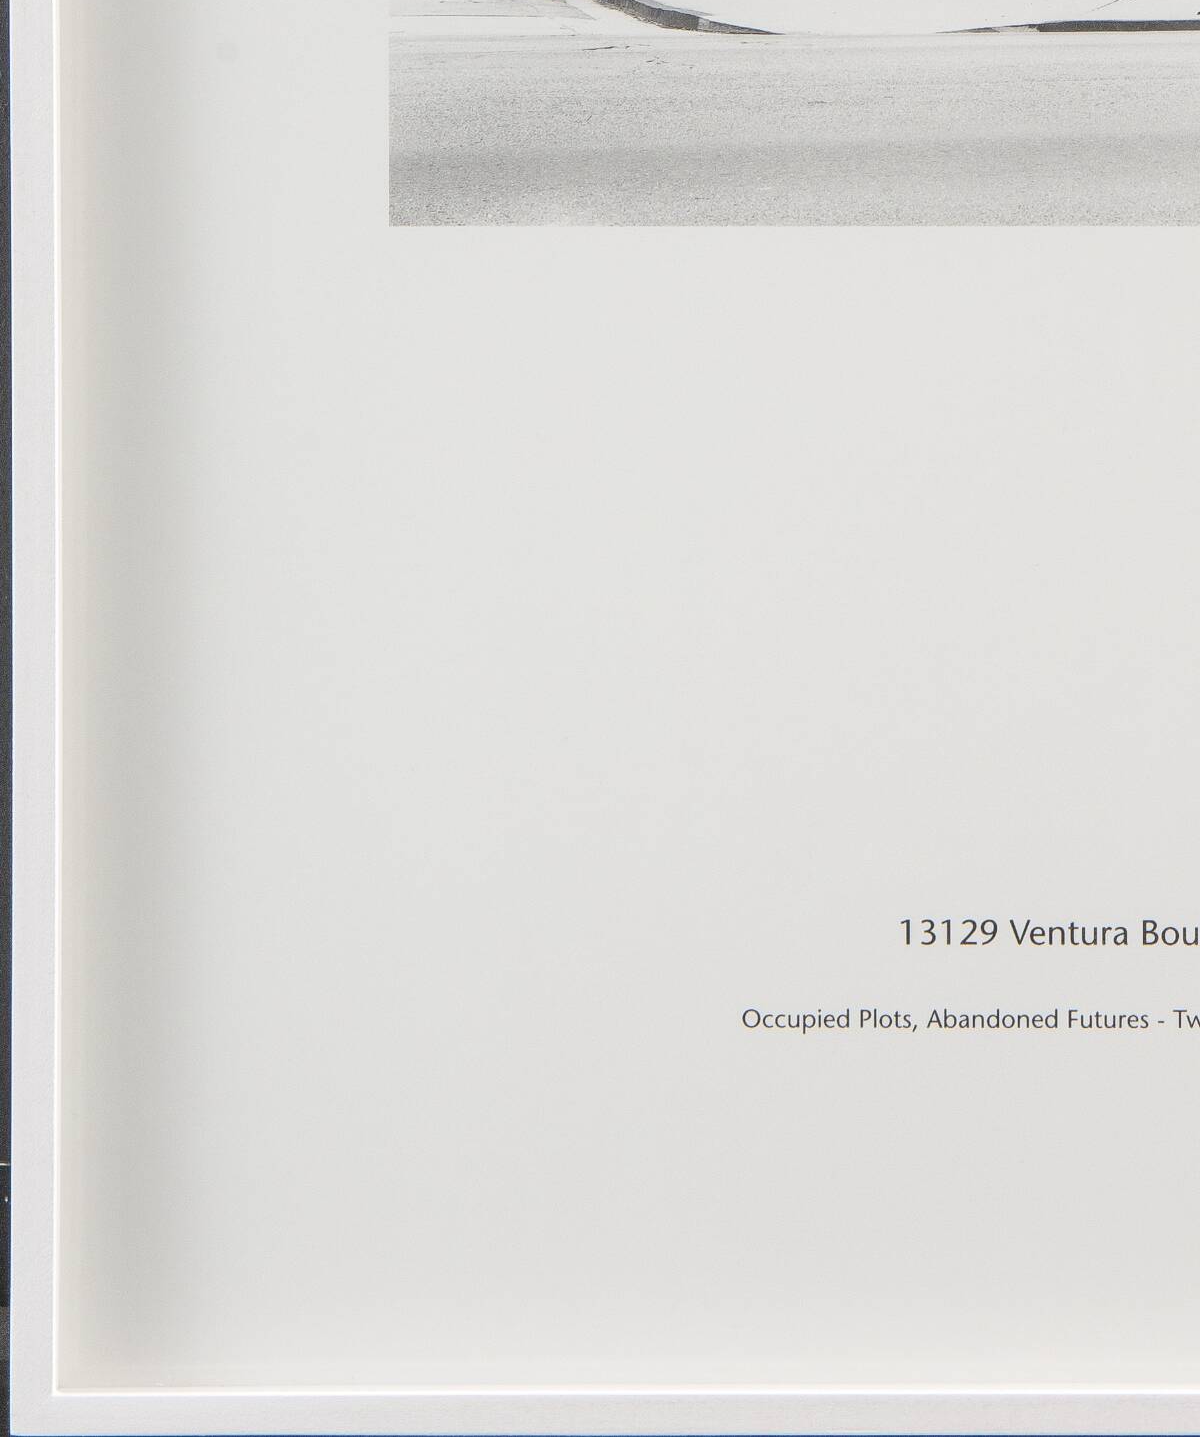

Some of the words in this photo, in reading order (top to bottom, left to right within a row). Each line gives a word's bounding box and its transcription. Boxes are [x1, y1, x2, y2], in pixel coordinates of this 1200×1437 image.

[900, 919, 998, 946] 13129
[1009, 919, 1128, 946] Ventura
[741, 1008, 850, 1035] Occupied
[860, 1008, 918, 1033] Plots,
[926, 1008, 1058, 1029] Abandoned
[1068, 1009, 1149, 1029] Futures
